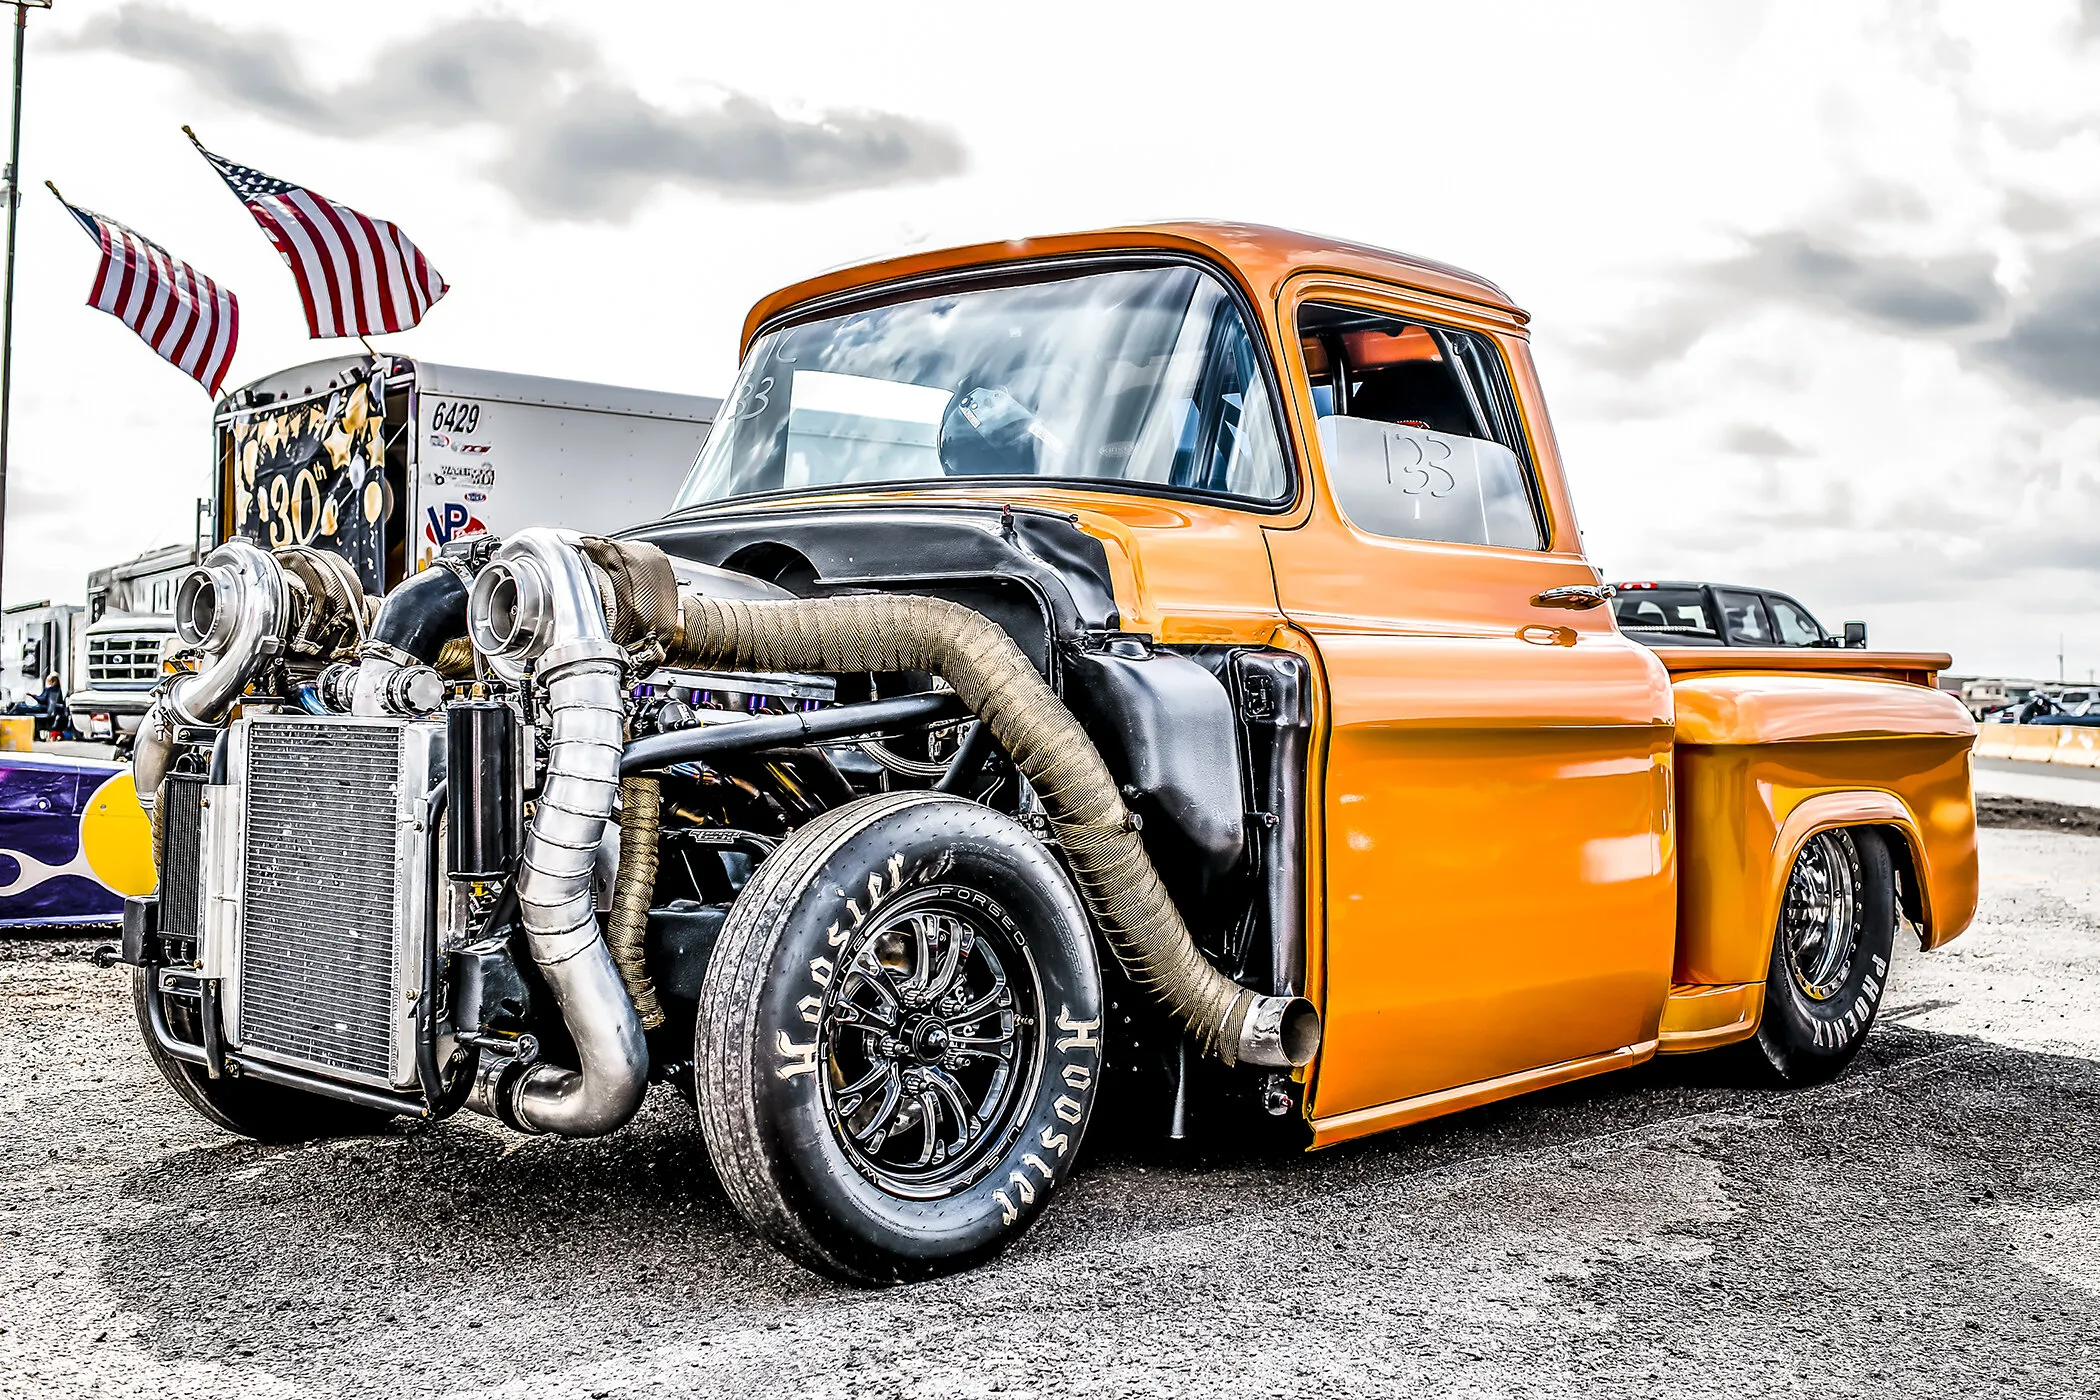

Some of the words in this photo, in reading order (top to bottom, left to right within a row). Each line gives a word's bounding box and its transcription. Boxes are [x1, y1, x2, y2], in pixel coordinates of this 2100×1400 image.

[432, 401, 480, 434] 6429
[1383, 431, 1455, 498] 133
[427, 502, 469, 548] VP
[939, 886, 1026, 946] FORGED
[1810, 953, 1887, 1048] PHOENIX
[992, 1004, 1100, 1226] Hoosier
